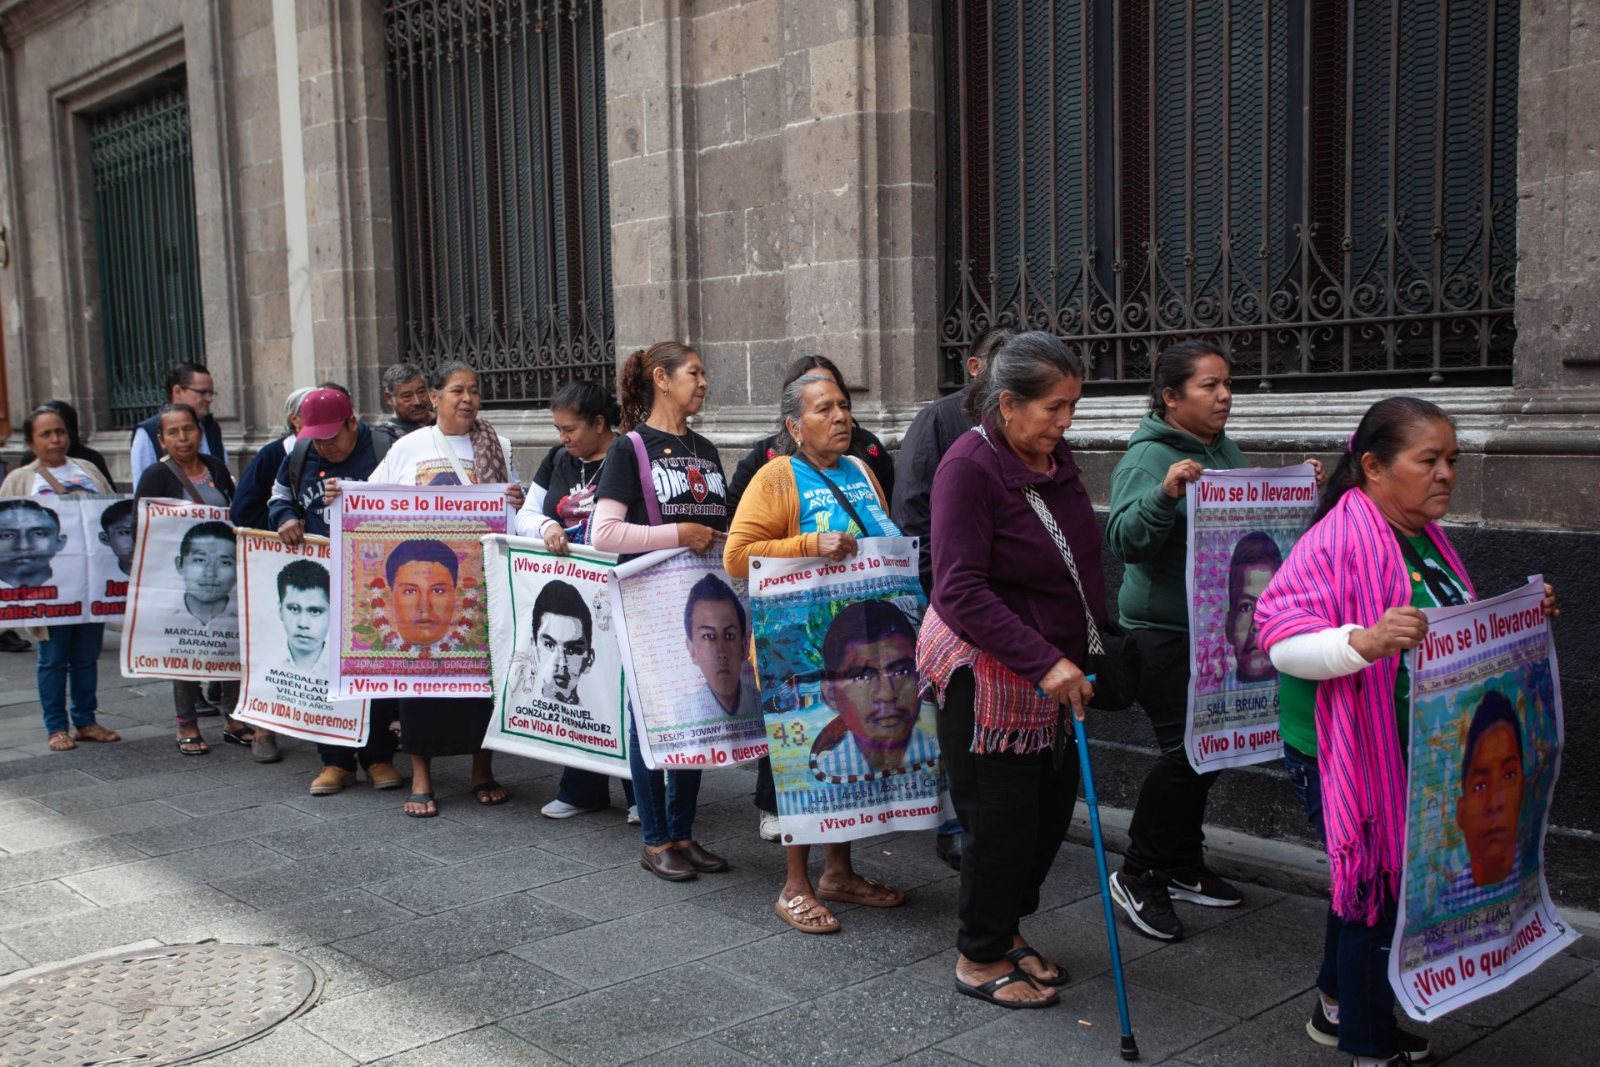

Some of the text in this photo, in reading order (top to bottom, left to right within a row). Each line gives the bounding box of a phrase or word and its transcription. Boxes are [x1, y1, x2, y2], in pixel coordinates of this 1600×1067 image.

[344, 494, 504, 513] ¡Vivo se lo llevaron!
[1197, 481, 1315, 508] ¡Vivo se lo llevaron!
[191, 507, 206, 519] se
[209, 507, 221, 520] lo
[247, 537, 282, 553] ¡Vivo
[285, 541, 299, 555] se
[302, 542, 314, 557] lo
[514, 557, 540, 573] ¡Vivo
[541, 562, 552, 574] se
[554, 560, 565, 575] lo
[759, 569, 812, 591] ¡Porque
[815, 563, 847, 577] vivo
[850, 561, 865, 572] se
[866, 557, 881, 569] lo
[164, 627, 210, 638] MARCIAL
[1417, 631, 1455, 671] ¡Vivo
[1456, 627, 1473, 652] se
[1473, 618, 1488, 645] lo
[1488, 599, 1546, 640] llevaron!
[178, 637, 228, 648] BARANDA
[135, 655, 159, 669] ¡Con
[162, 656, 190, 670] VIDA
[192, 657, 203, 670] lo
[391, 659, 439, 669] TRUJILLO
[349, 678, 389, 695] ¡Vivo
[393, 678, 408, 693] lo
[276, 694, 296, 704] EDAD
[308, 701, 335, 712] AÑOS
[532, 698, 594, 721] CÉSAR MANUEL
[1235, 695, 1268, 713] BRUNO
[248, 697, 358, 732] ¡Con VIDA lo queremos!
[515, 706, 612, 735] GONZÁLEZ HERNÁNDEZ
[508, 715, 618, 749] ¡Con VIDA lo queremos!
[658, 730, 686, 743] JESÚS
[690, 724, 722, 738] JOVANY
[1198, 734, 1230, 761] ¡Vivo
[1233, 731, 1246, 750] lo
[710, 747, 728, 765] lo
[820, 816, 856, 833] ¡Vivo
[859, 812, 874, 825] lo
[1413, 965, 1457, 1006] ¡Vivo
[1458, 954, 1476, 981] lo
